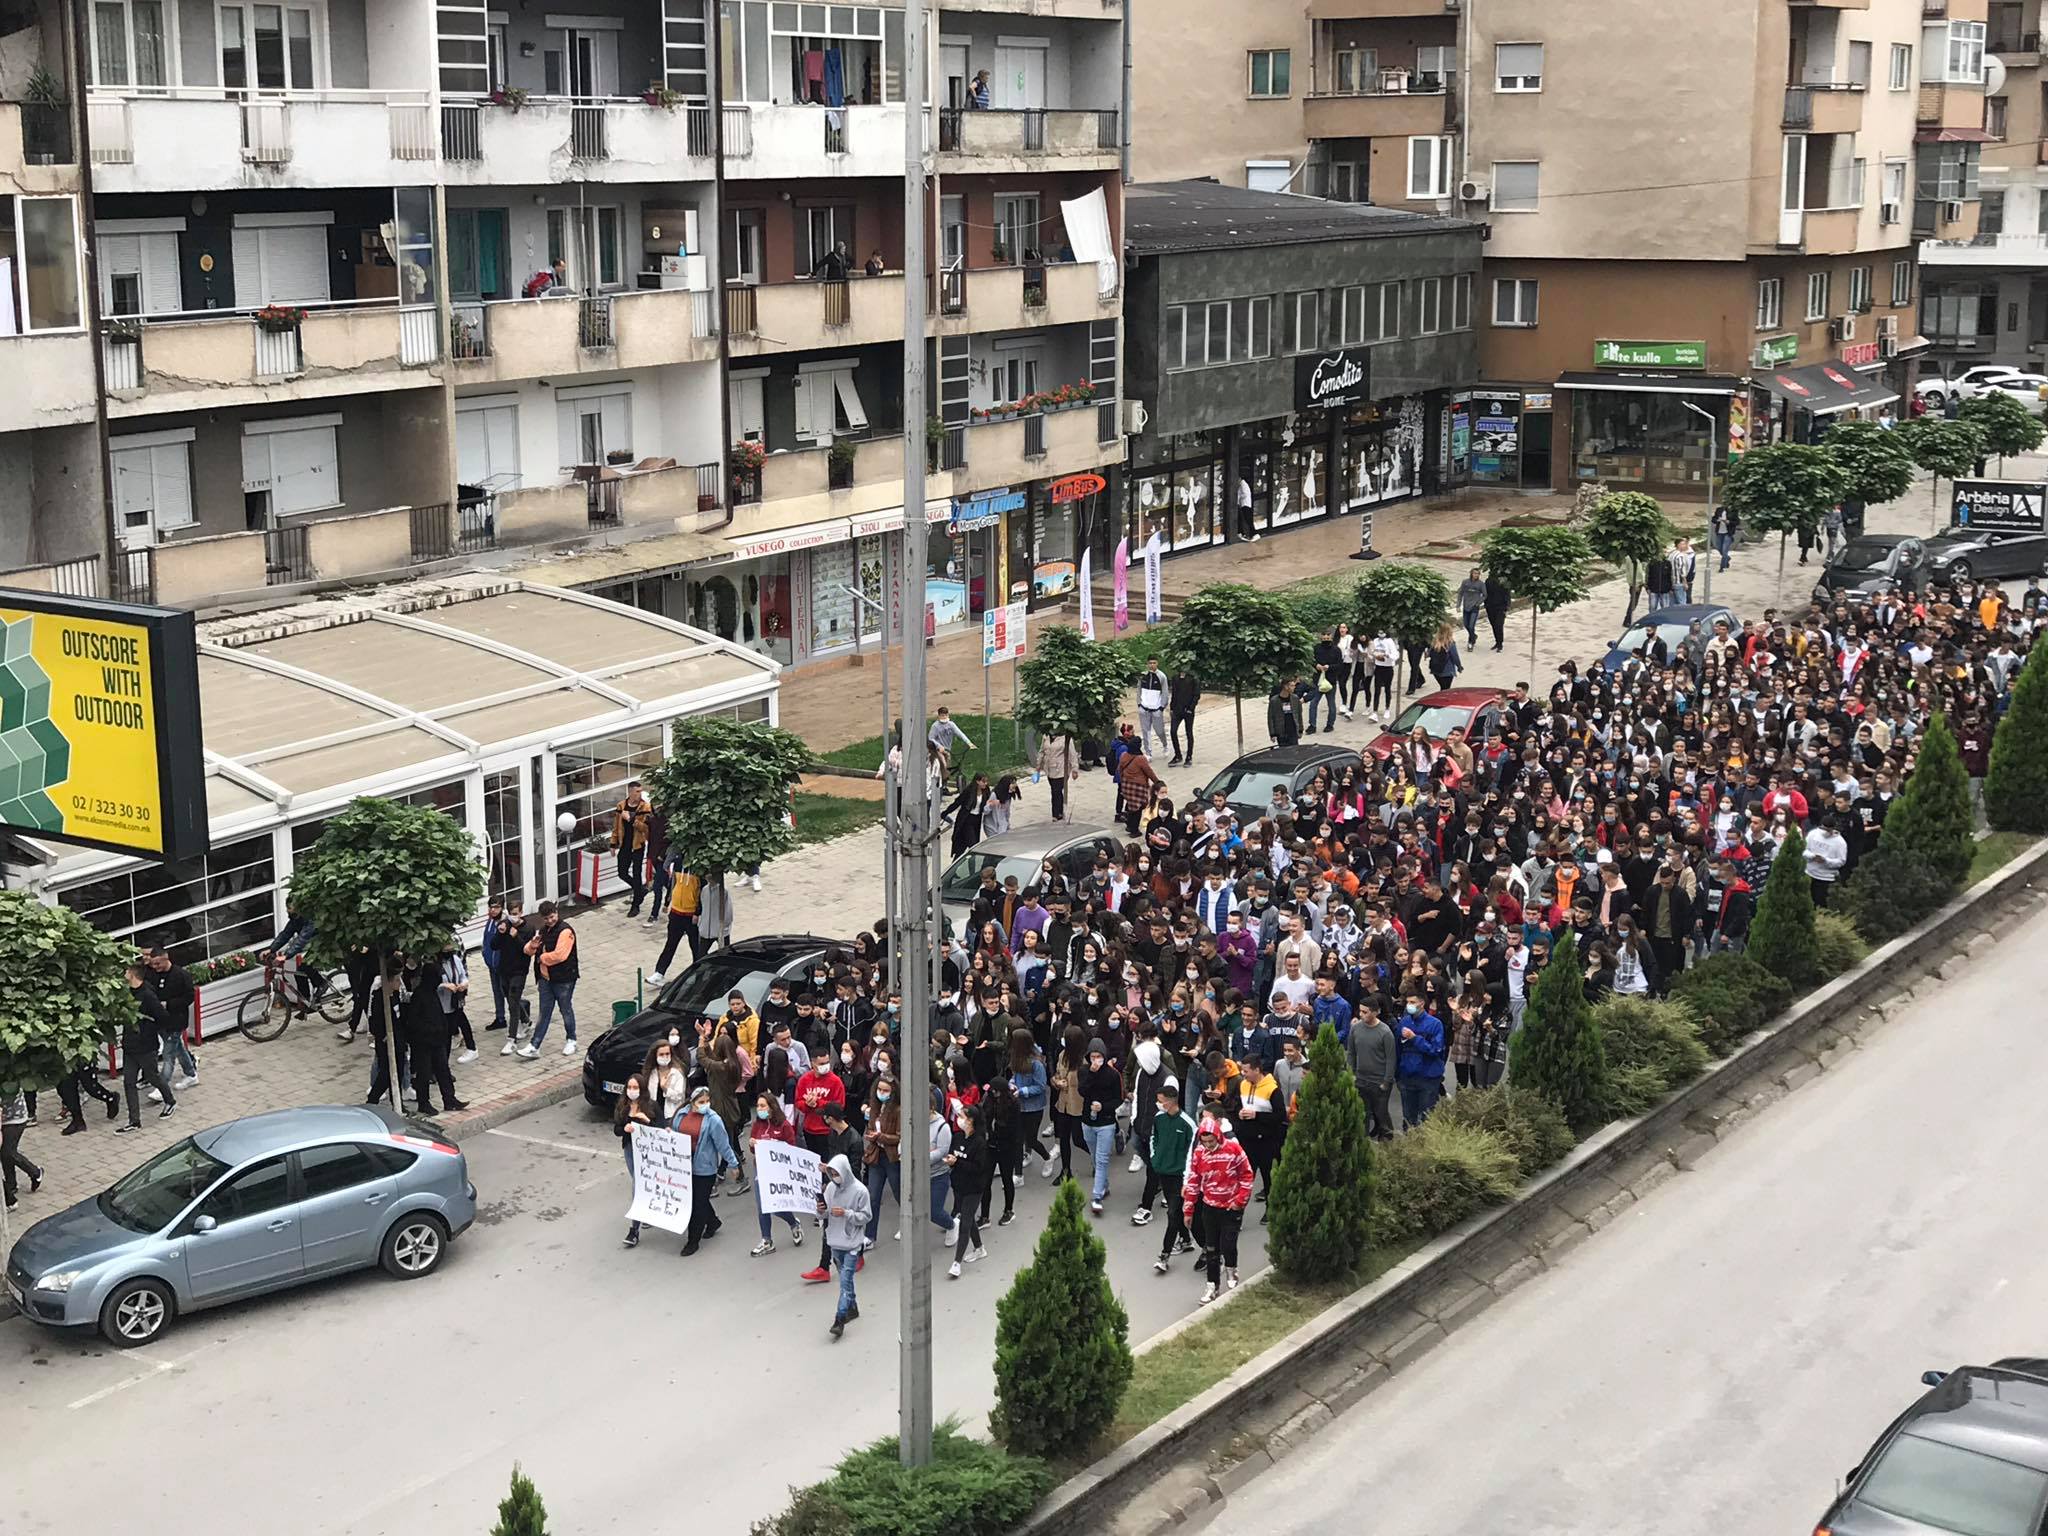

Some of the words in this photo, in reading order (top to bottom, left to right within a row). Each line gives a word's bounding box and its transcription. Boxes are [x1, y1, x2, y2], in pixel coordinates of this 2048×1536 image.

[1973, 504, 2009, 517] Design
[860, 520, 880, 534] STOLI
[960, 516, 999, 532] MoneyGram
[746, 540, 785, 556] VUSEGO
[789, 535, 824, 548] COLLECTION
[62, 629, 139, 665] OUTSCORE
[102, 667, 141, 697] WITH
[74, 695, 144, 730] OUTDOOR
[73, 795, 86, 809] 02
[96, 799, 116, 815] 323
[120, 803, 133, 818] 30
[136, 806, 150, 820] 30
[769, 1150, 791, 1164] DUAM
[789, 1170, 808, 1184] DUAM
[769, 1183, 794, 1195] DUAM
